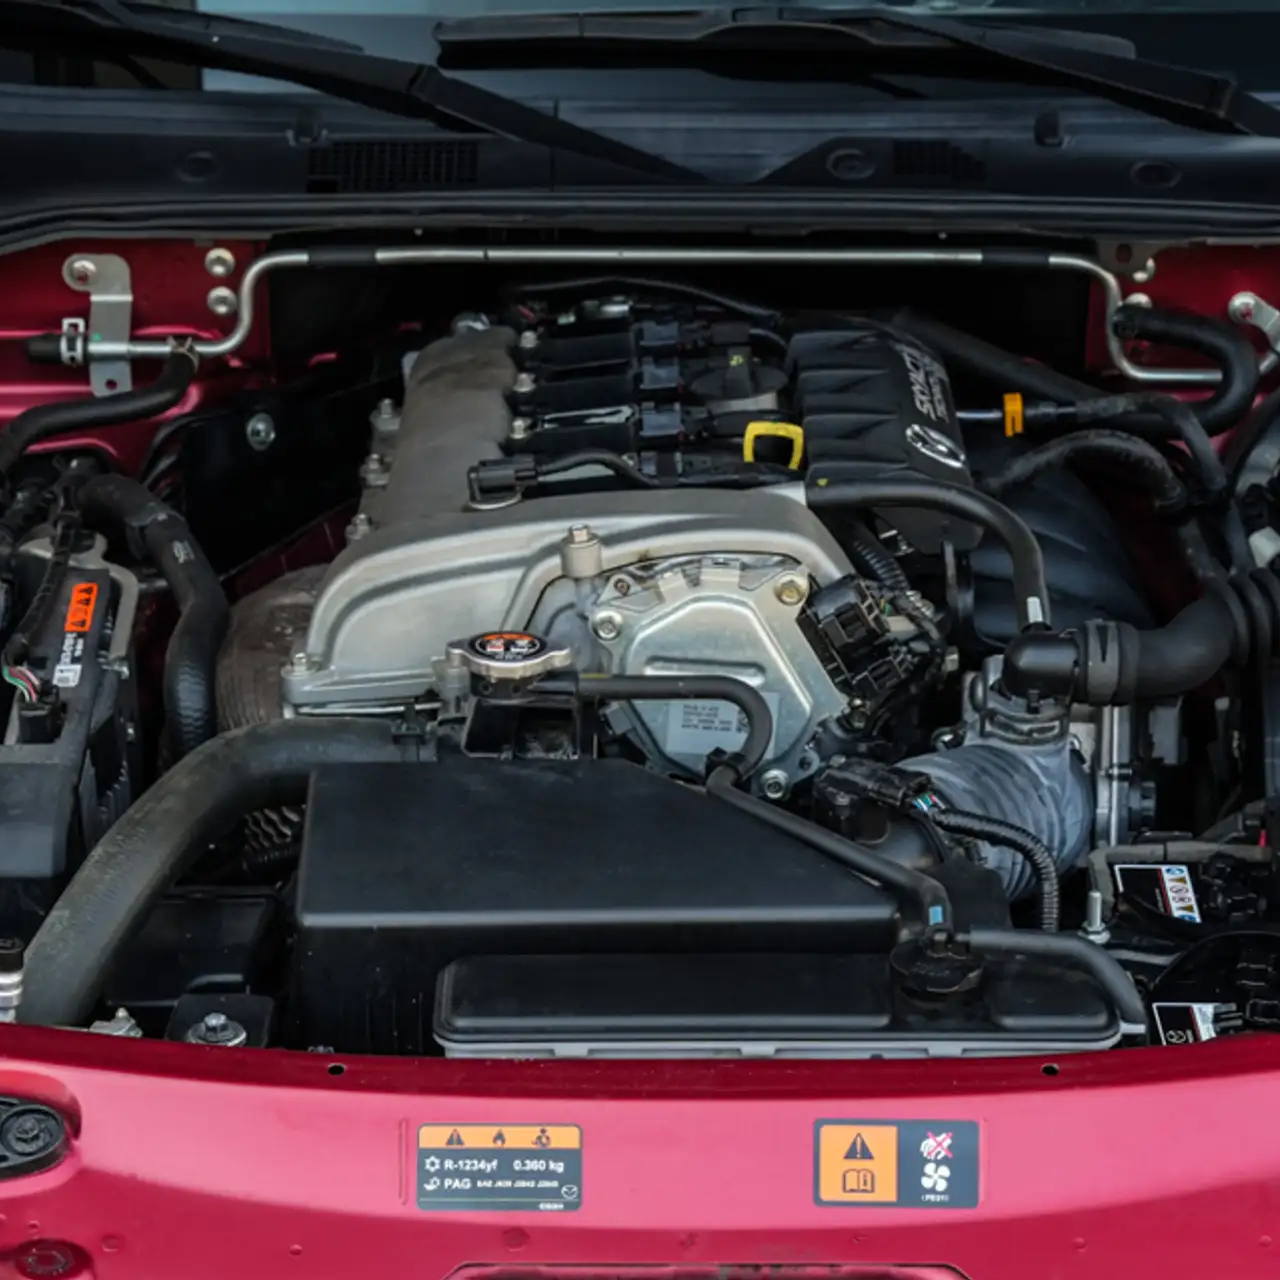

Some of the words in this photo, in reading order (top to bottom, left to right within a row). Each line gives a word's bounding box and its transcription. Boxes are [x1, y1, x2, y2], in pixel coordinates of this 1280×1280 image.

[444, 1159, 498, 1173] R-1234yf
[549, 1159, 564, 1174] kg
[444, 1178, 472, 1190] PAG
